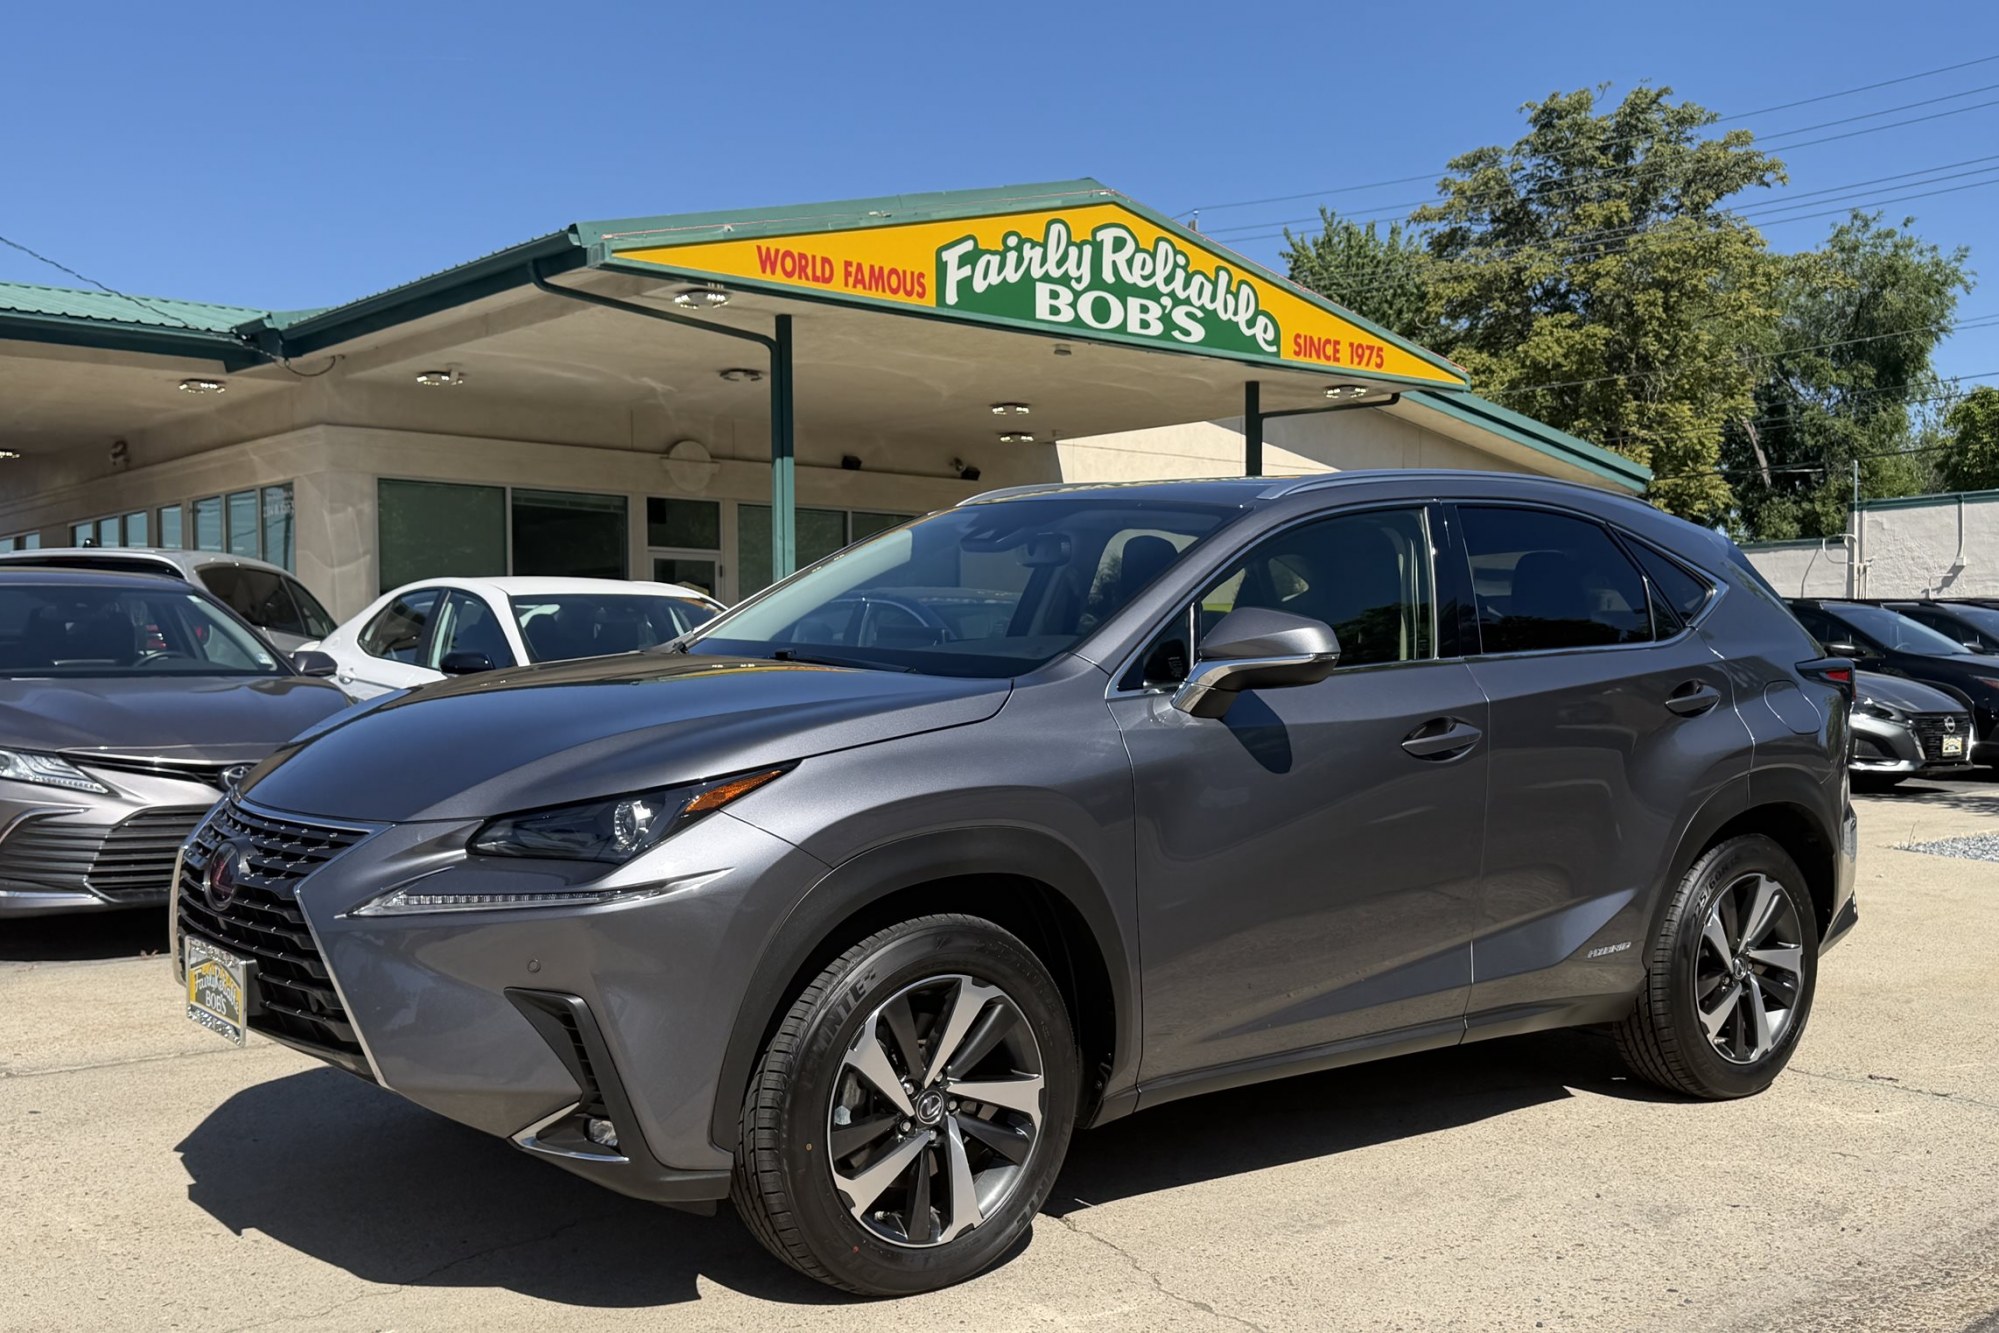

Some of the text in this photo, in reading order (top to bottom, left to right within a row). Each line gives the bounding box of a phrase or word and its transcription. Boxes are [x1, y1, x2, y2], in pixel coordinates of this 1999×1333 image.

[756, 245, 927, 299] WORLD FAMOUS
[942, 223, 1277, 352] Fairly Reliable
[1035, 281, 1206, 343] BOB'S
[1293, 332, 1384, 369] SINCE 1975
[205, 990, 227, 1015] BOB'S
